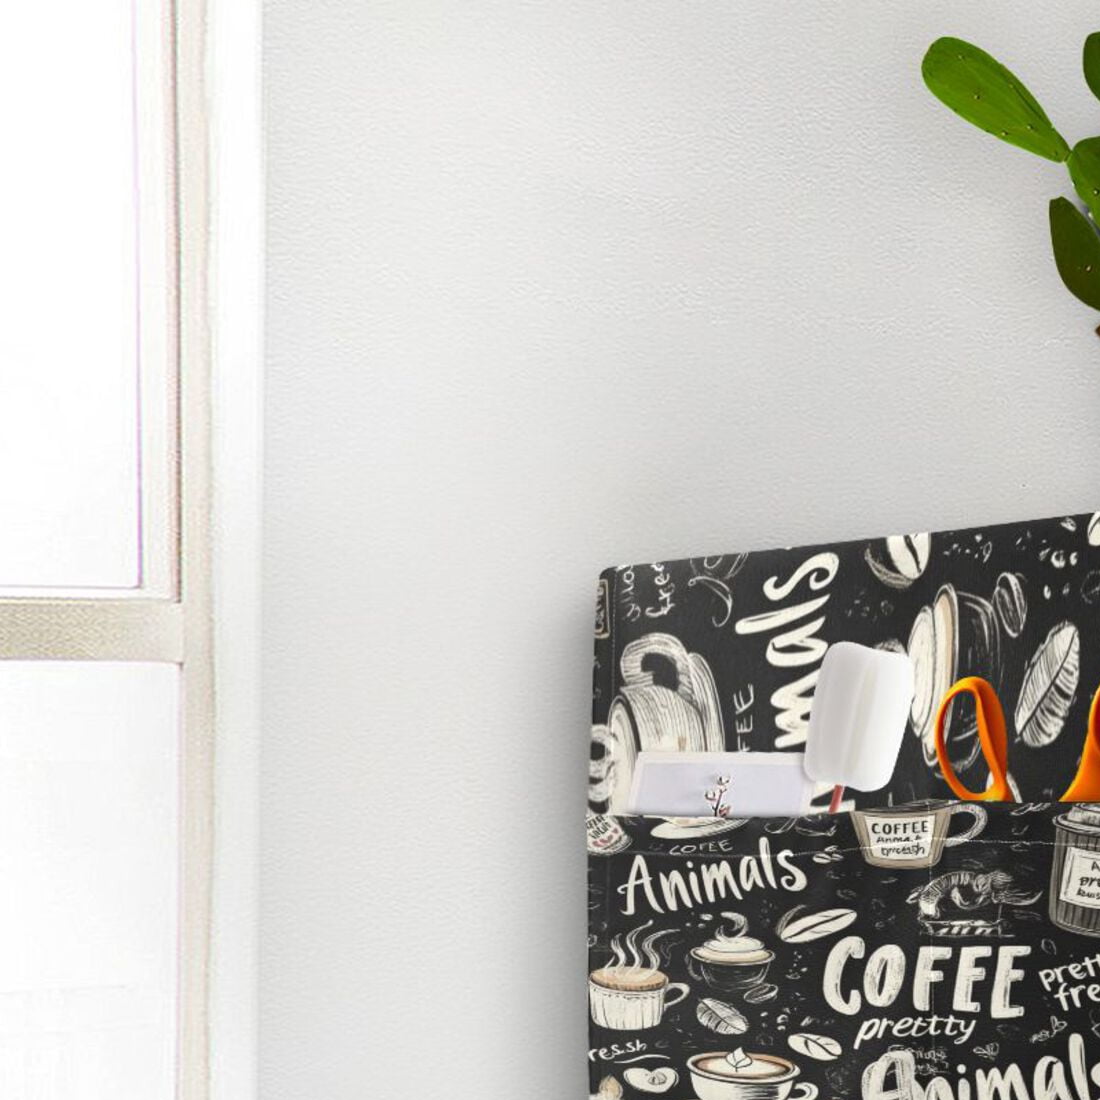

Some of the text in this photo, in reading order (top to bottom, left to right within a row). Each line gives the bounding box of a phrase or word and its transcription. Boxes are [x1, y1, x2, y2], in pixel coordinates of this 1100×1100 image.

[870, 820, 929, 836] COFFEE
[617, 837, 808, 916] Animals
[823, 935, 1033, 1020] COFEE
